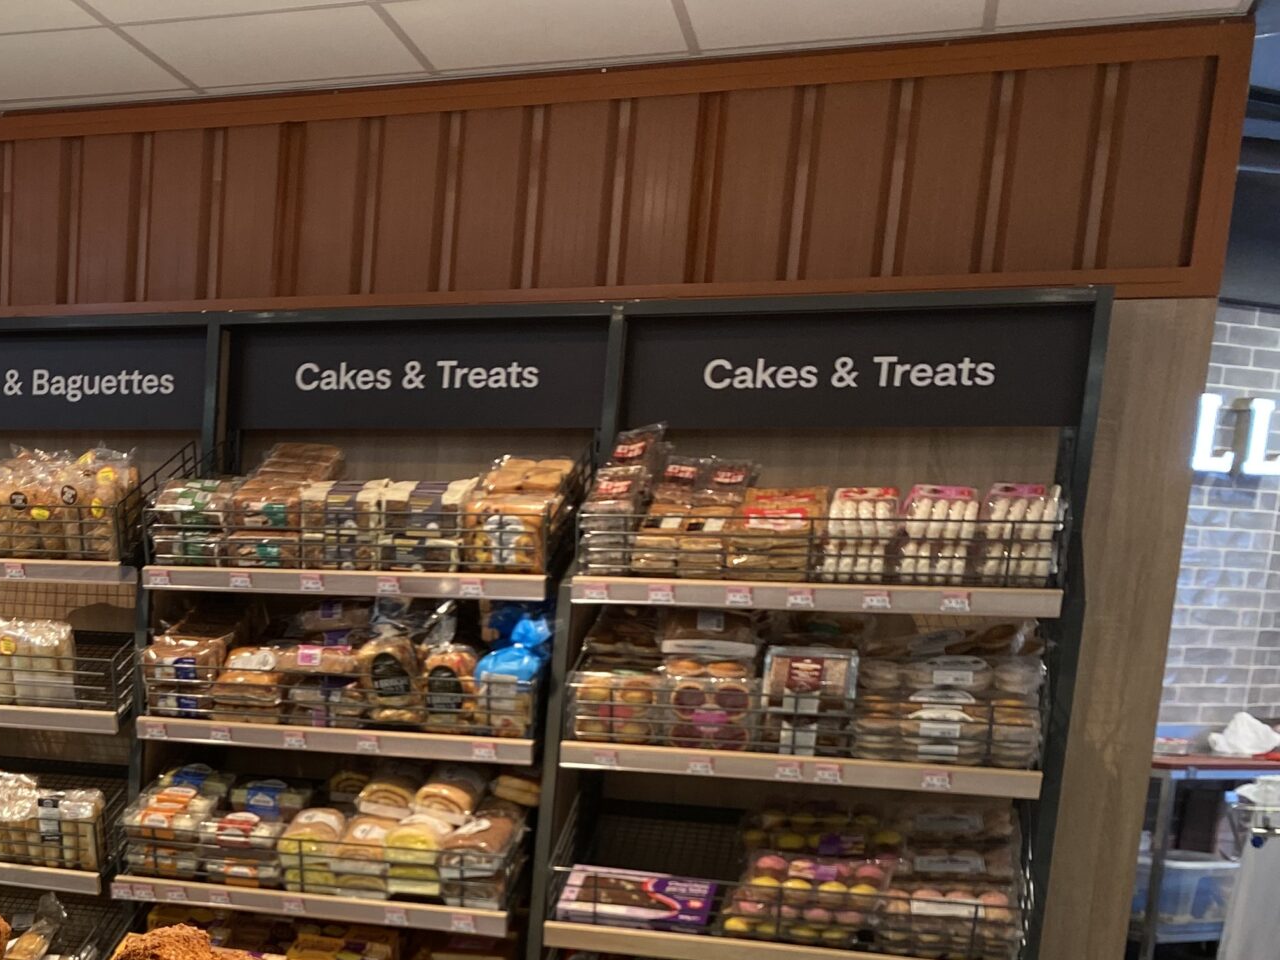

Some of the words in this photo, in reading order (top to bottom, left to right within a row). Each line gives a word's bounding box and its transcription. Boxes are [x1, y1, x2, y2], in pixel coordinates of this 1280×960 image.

[3, 369, 23, 396] &
[32, 368, 175, 402] Baguettes
[295, 362, 392, 391] Cakes
[401, 361, 425, 390] &
[437, 360, 539, 390] Treats
[704, 358, 818, 389] Cakes
[830, 356, 859, 388] &
[873, 355, 996, 387] Treats
